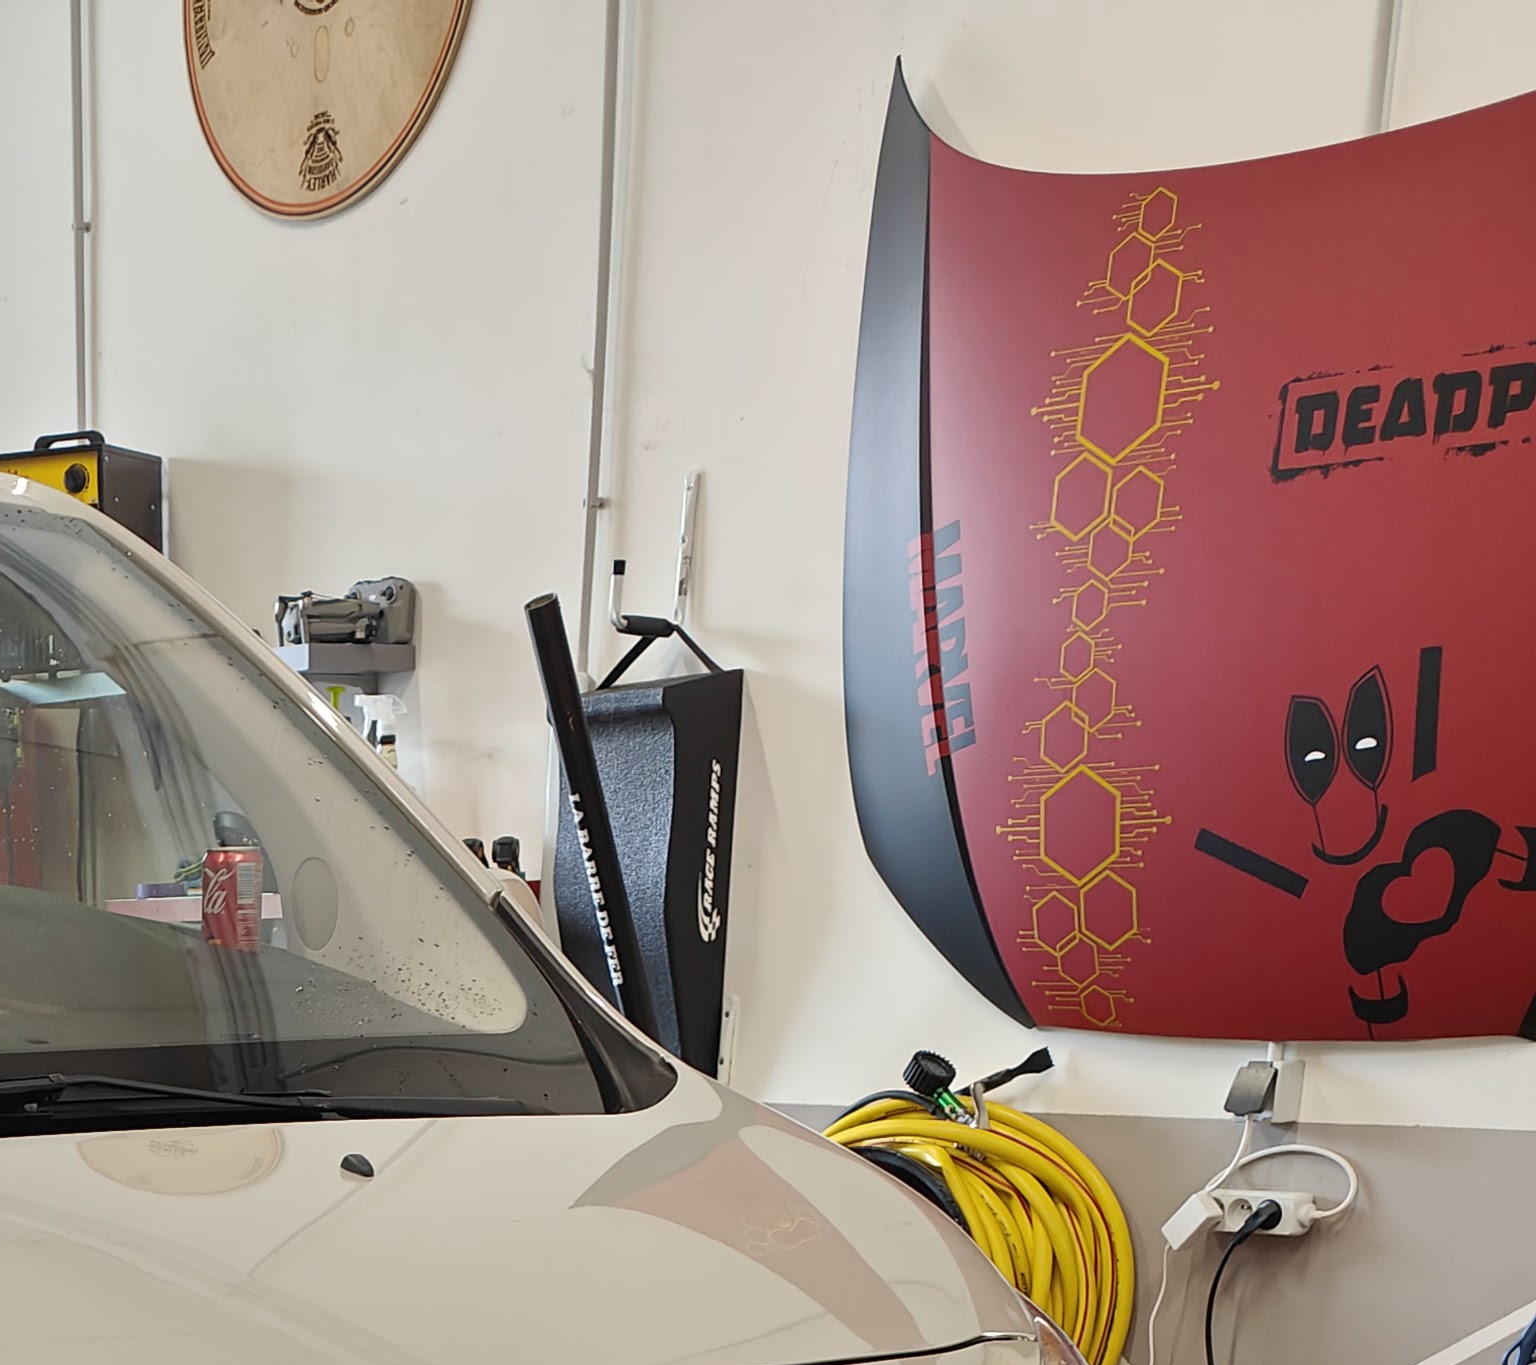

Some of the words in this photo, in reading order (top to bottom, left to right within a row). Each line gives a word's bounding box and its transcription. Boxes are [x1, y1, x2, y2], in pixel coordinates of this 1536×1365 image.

[906, 519, 977, 777] MARVEL
[568, 792, 585, 824] LA
[706, 758, 722, 848] RAMPS
[576, 828, 606, 912] BARRE
[702, 848, 717, 913] RACE
[595, 909, 614, 946] DE
[605, 943, 624, 987] FER
